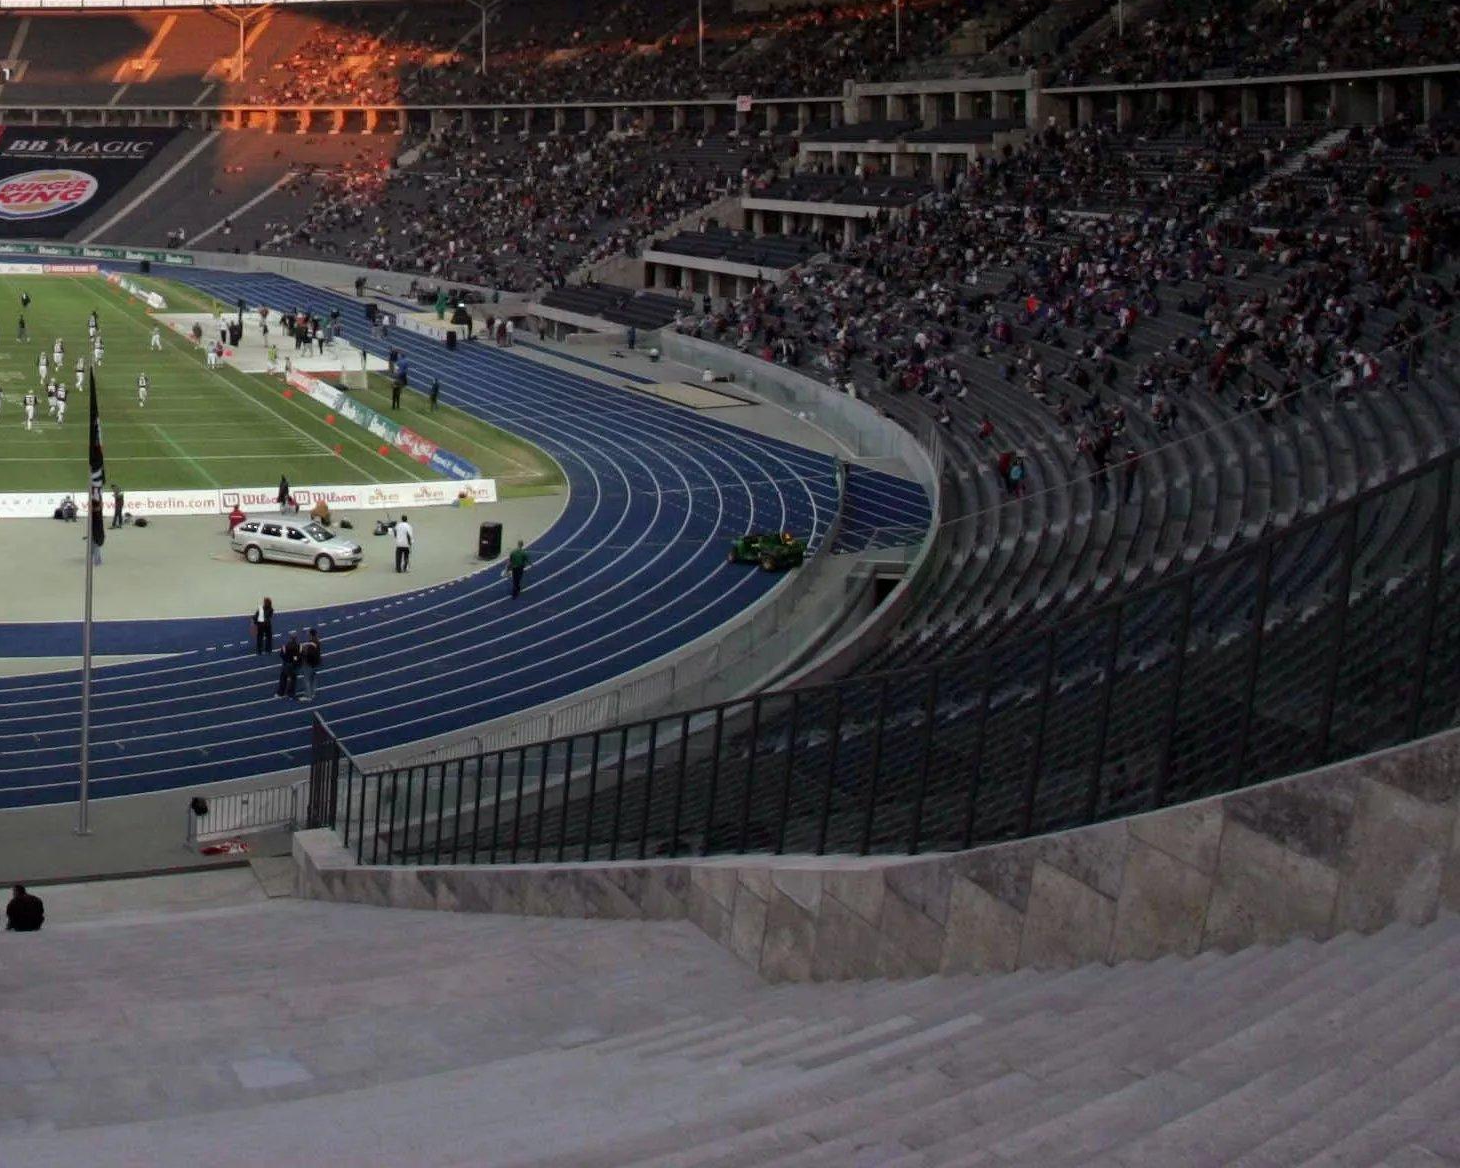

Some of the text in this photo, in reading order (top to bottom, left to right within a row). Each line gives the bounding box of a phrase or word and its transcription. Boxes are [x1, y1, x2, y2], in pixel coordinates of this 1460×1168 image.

[9, 137, 154, 154] BB MAGIC
[0, 180, 91, 193] BURGER
[312, 490, 357, 504] Wilson
